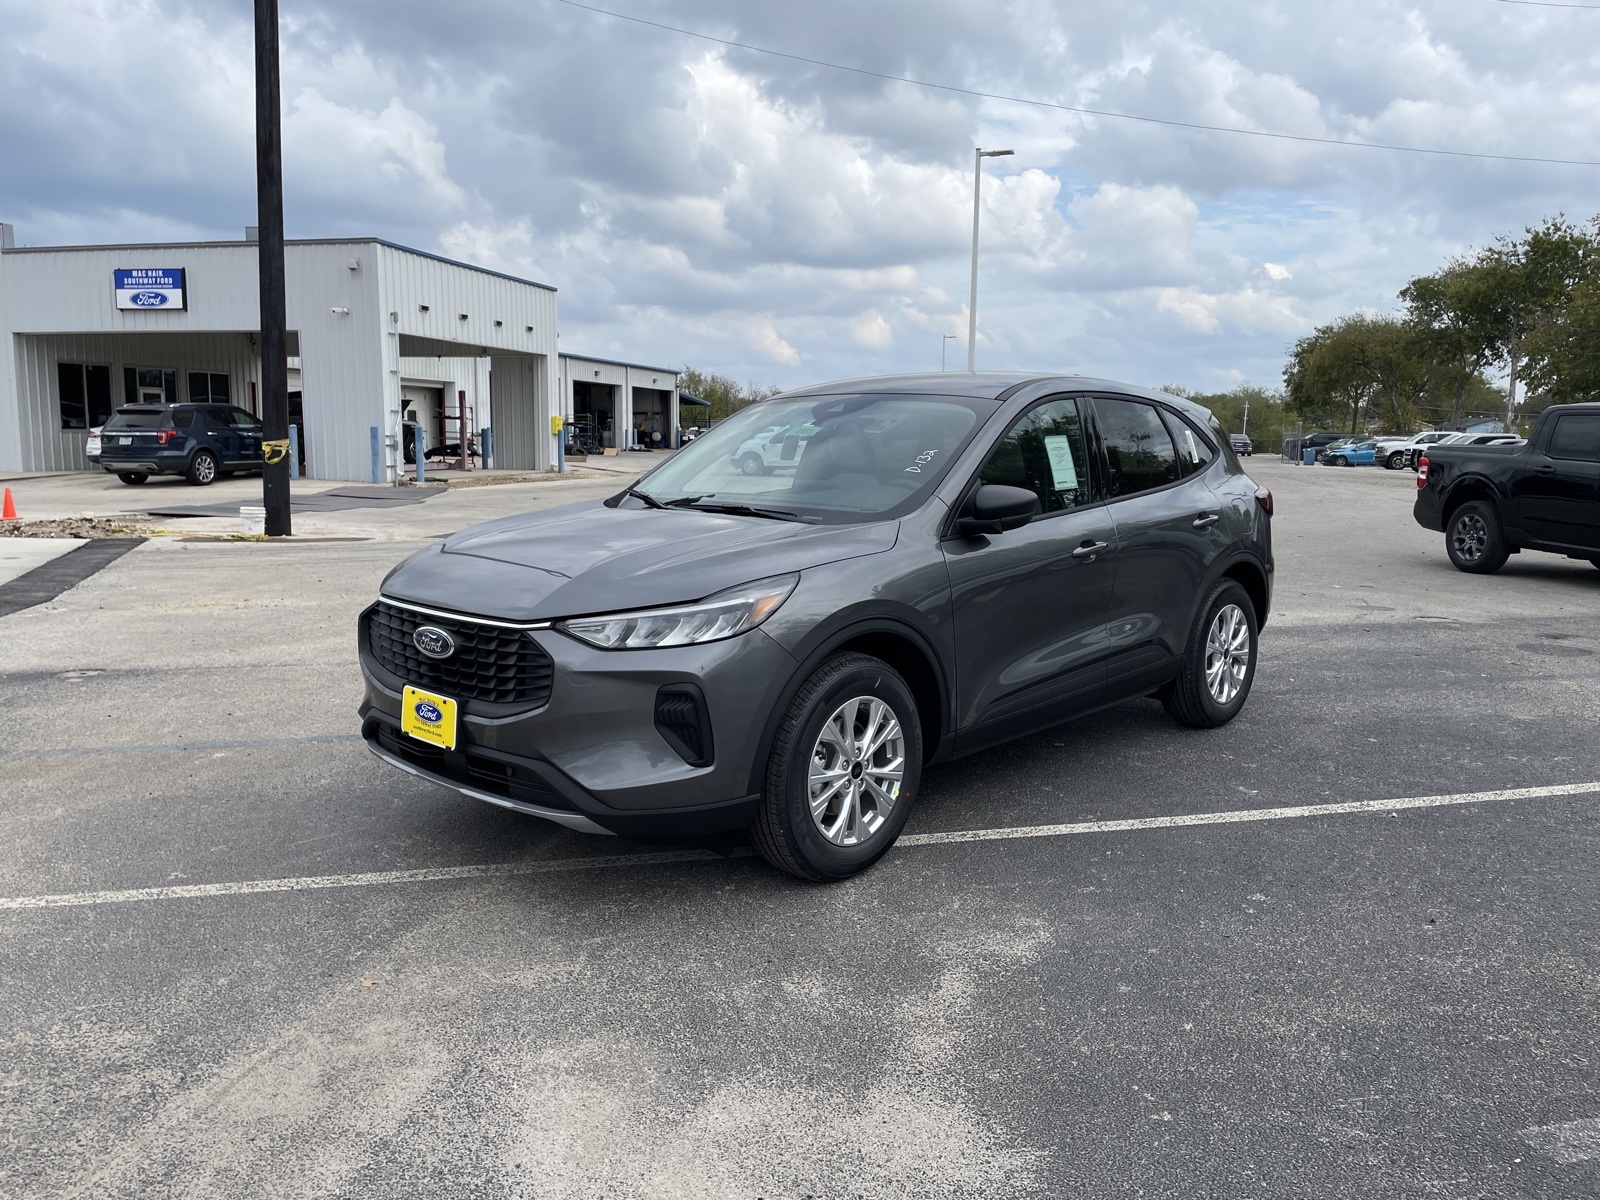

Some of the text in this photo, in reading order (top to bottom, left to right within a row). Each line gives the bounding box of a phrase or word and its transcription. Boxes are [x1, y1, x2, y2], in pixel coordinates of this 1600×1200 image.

[137, 293, 162, 305] Ford
[904, 450, 938, 472] D-132
[420, 632, 442, 652] Ford
[420, 704, 438, 720] Ford
